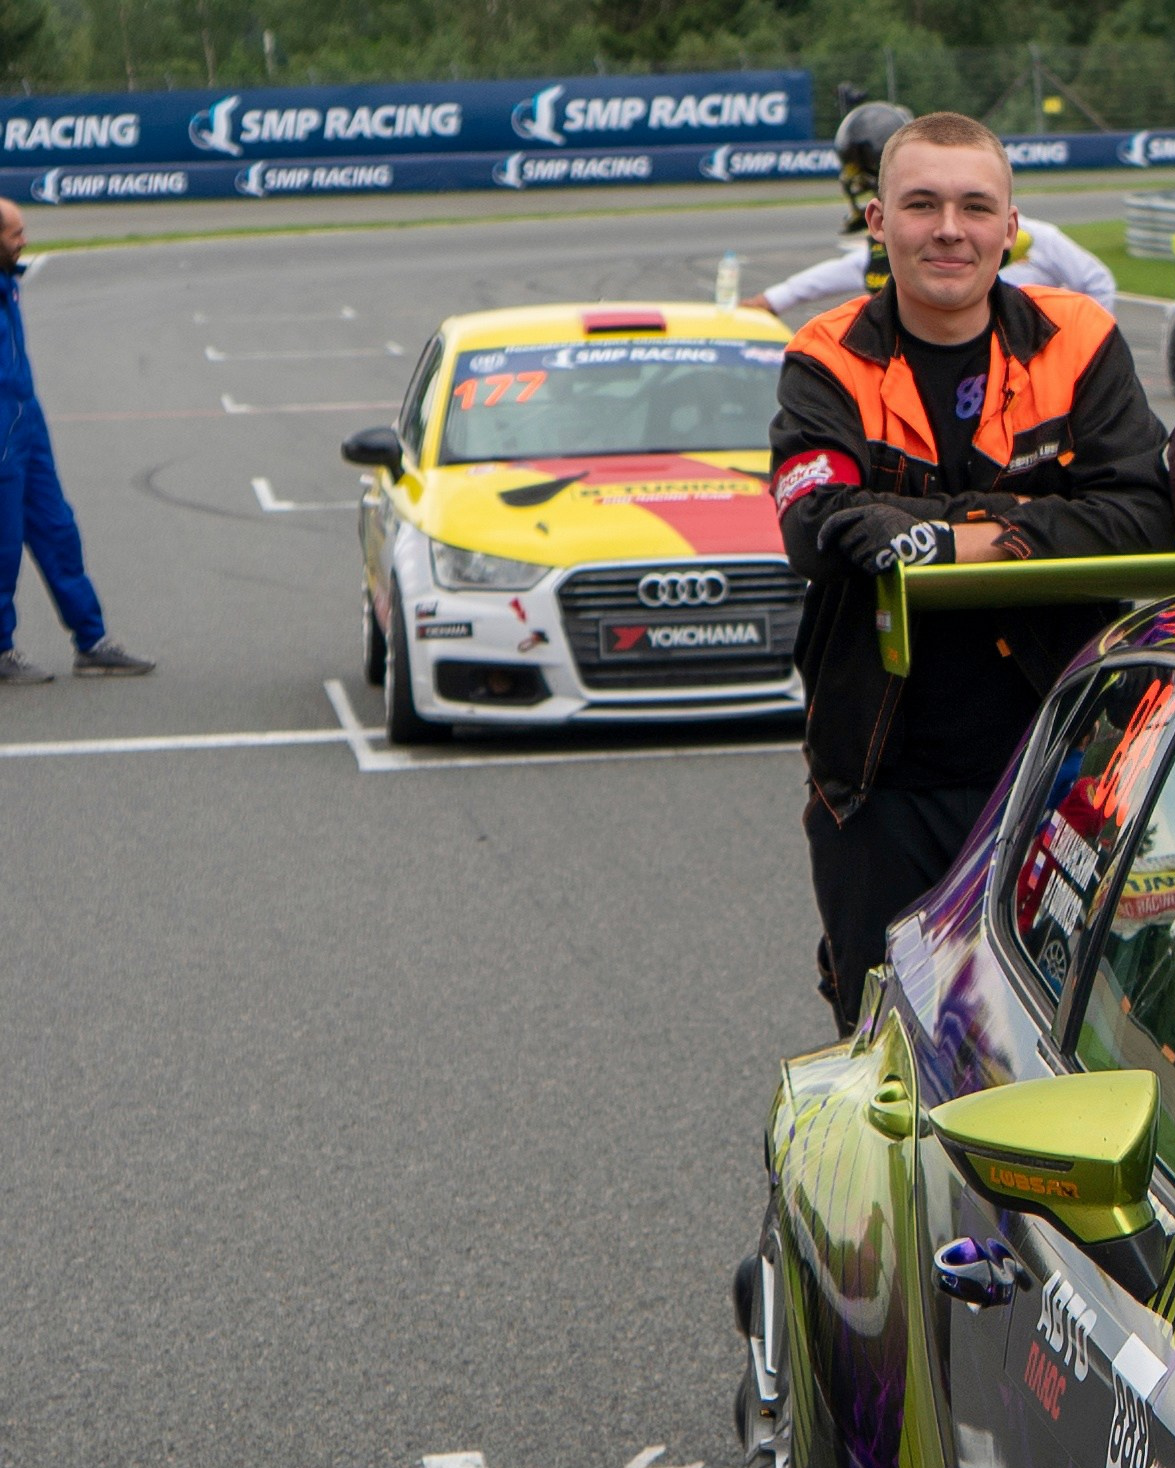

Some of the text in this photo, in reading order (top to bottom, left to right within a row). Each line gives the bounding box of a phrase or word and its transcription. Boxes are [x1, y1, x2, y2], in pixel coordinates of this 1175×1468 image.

[240, 103, 462, 143] SMP RACING
[564, 91, 789, 131] SMP RACING
[4, 113, 140, 151] RACING
[730, 148, 841, 173] SMP RACIN
[1003, 141, 1067, 166] ACING
[264, 165, 393, 189] SMP RACING
[522, 155, 652, 180] SMP RACING
[60, 171, 189, 196] SMP RACING
[575, 347, 718, 364] SMP RACING
[454, 370, 546, 411] 177
[648, 622, 759, 648] YOKOHAMA
[1036, 1269, 1098, 1383] АВТО
